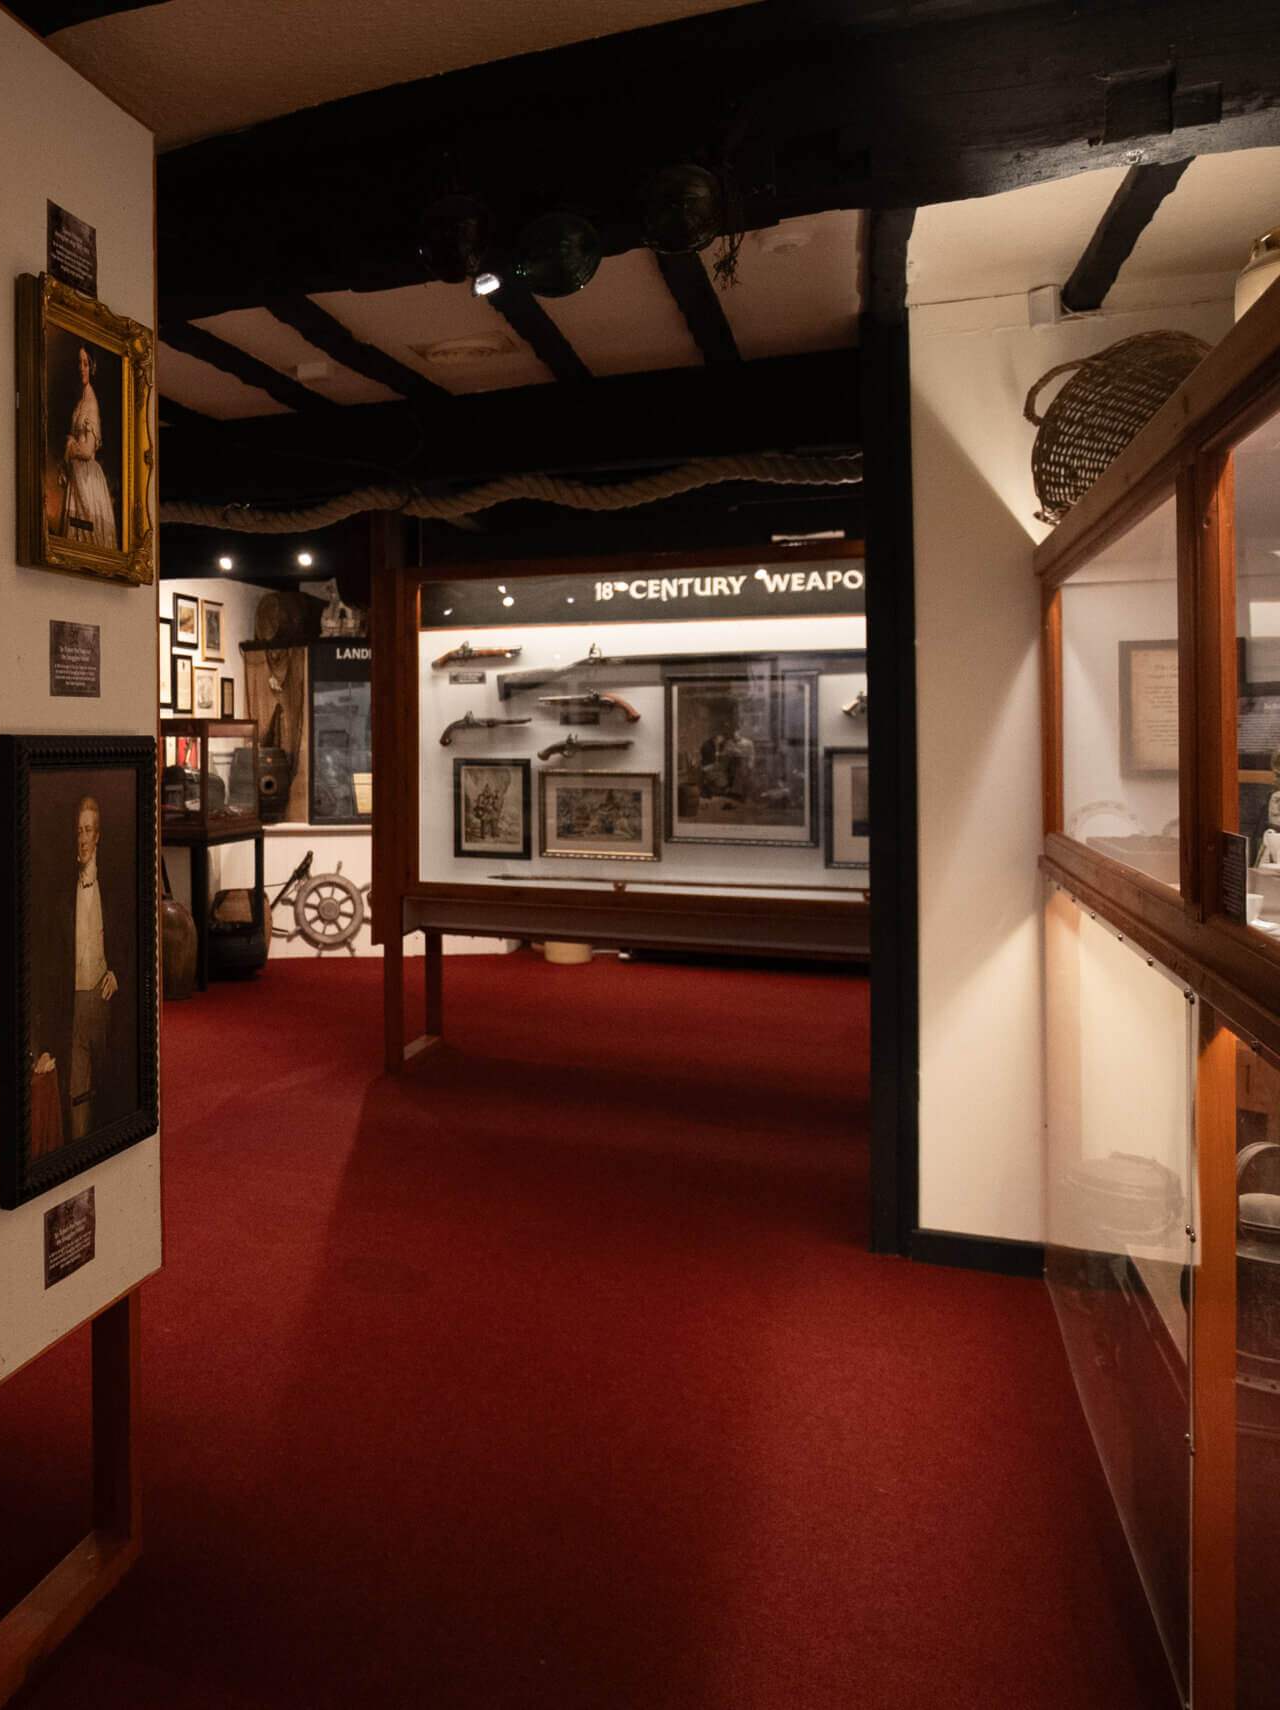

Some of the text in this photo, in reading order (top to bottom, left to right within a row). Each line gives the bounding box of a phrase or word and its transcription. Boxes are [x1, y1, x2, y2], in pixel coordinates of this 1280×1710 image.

[595, 569, 864, 602] 18 CENTURY WEAPO
